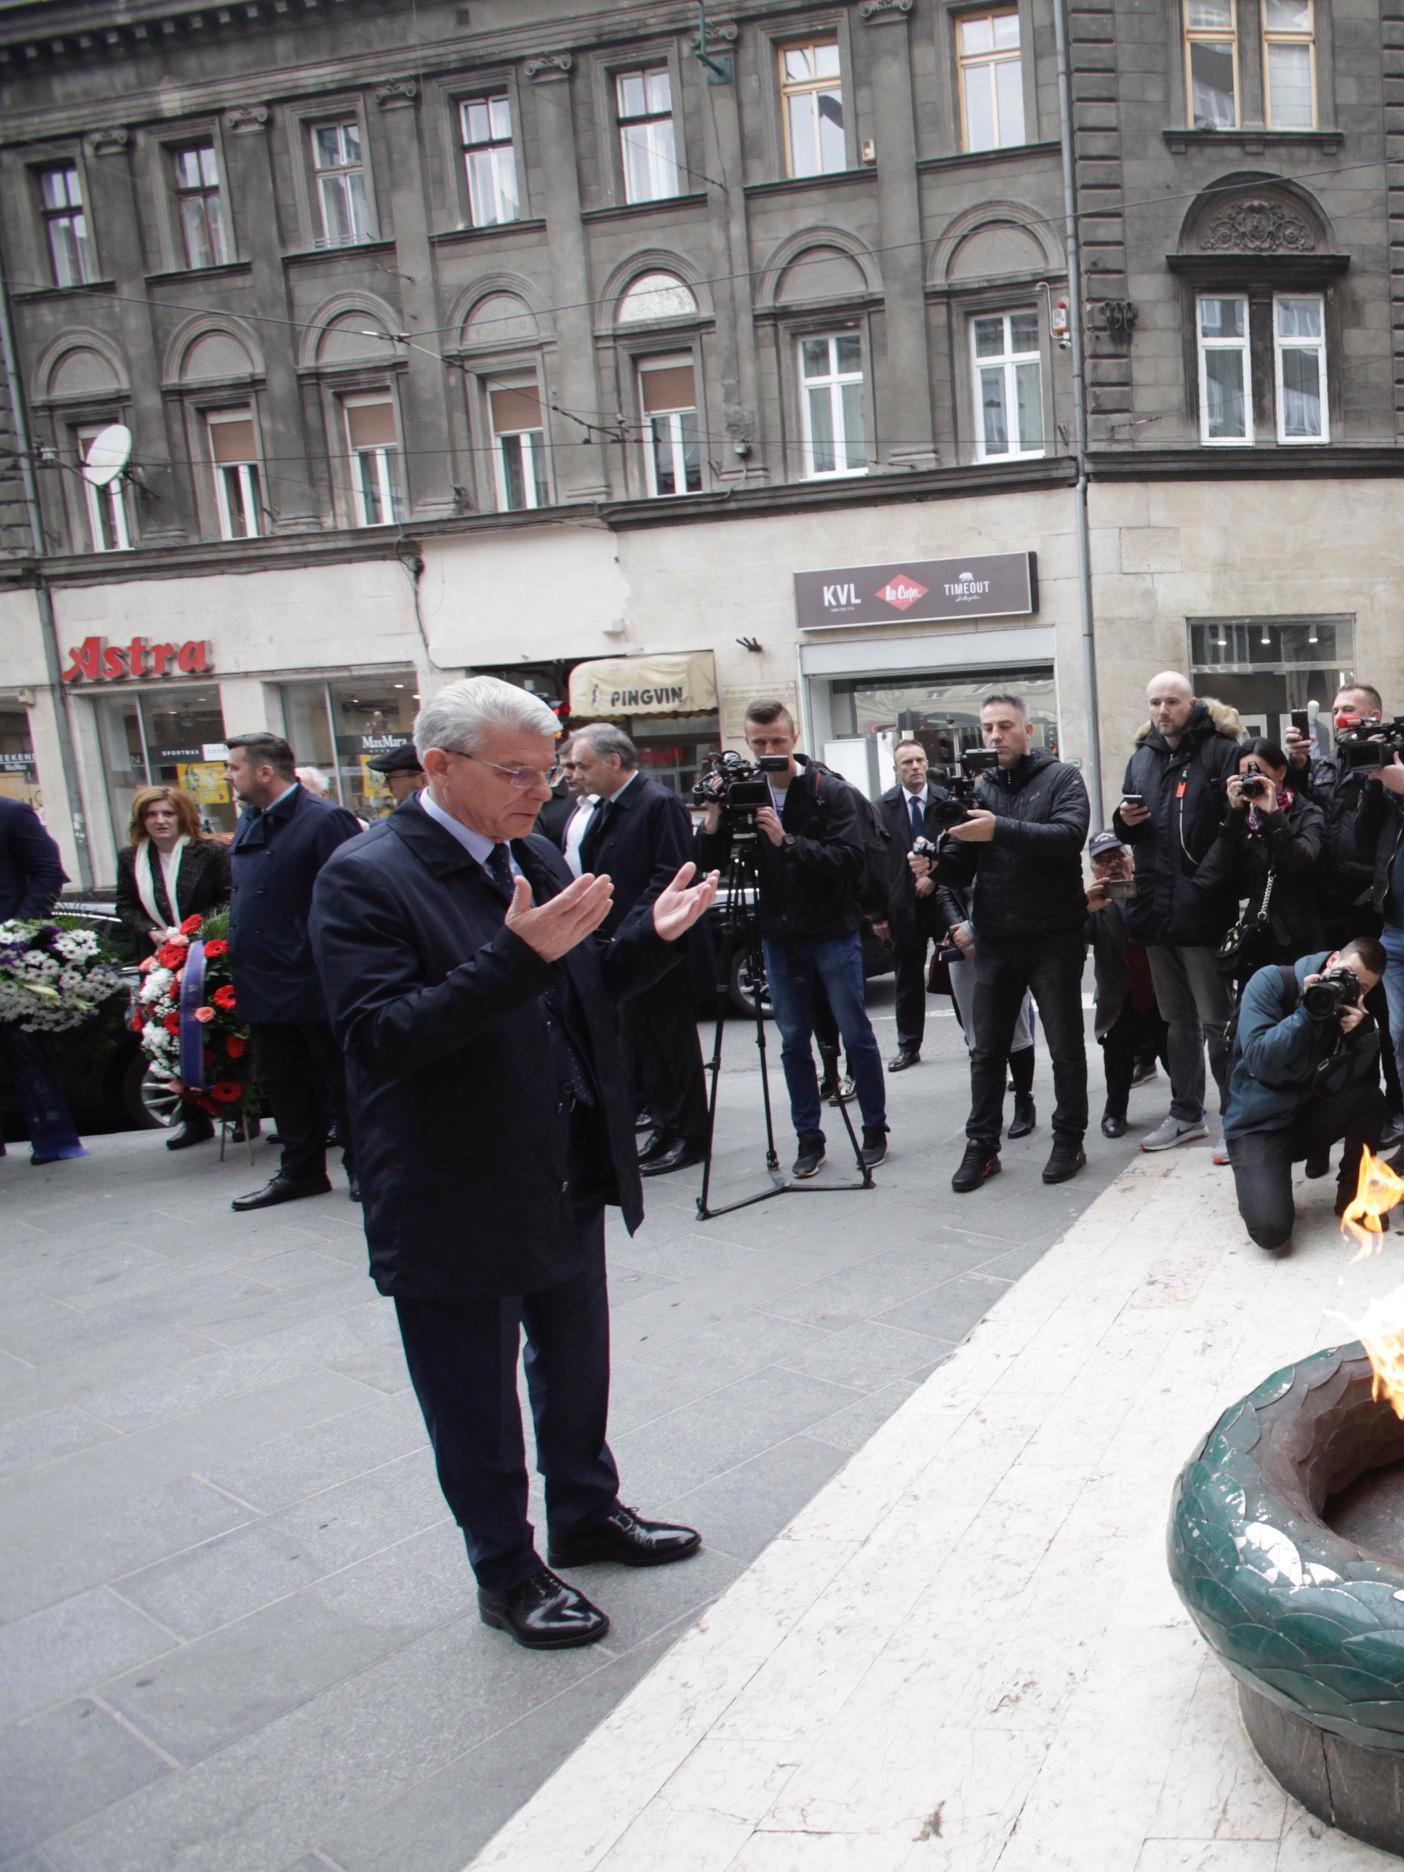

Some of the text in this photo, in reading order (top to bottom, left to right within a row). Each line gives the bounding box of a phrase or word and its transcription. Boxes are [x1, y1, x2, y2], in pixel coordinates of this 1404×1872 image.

[823, 583, 862, 607] KVL
[943, 580, 990, 596] TIMEOUT
[63, 636, 210, 682] Astra
[611, 686, 684, 707] PINGVIN
